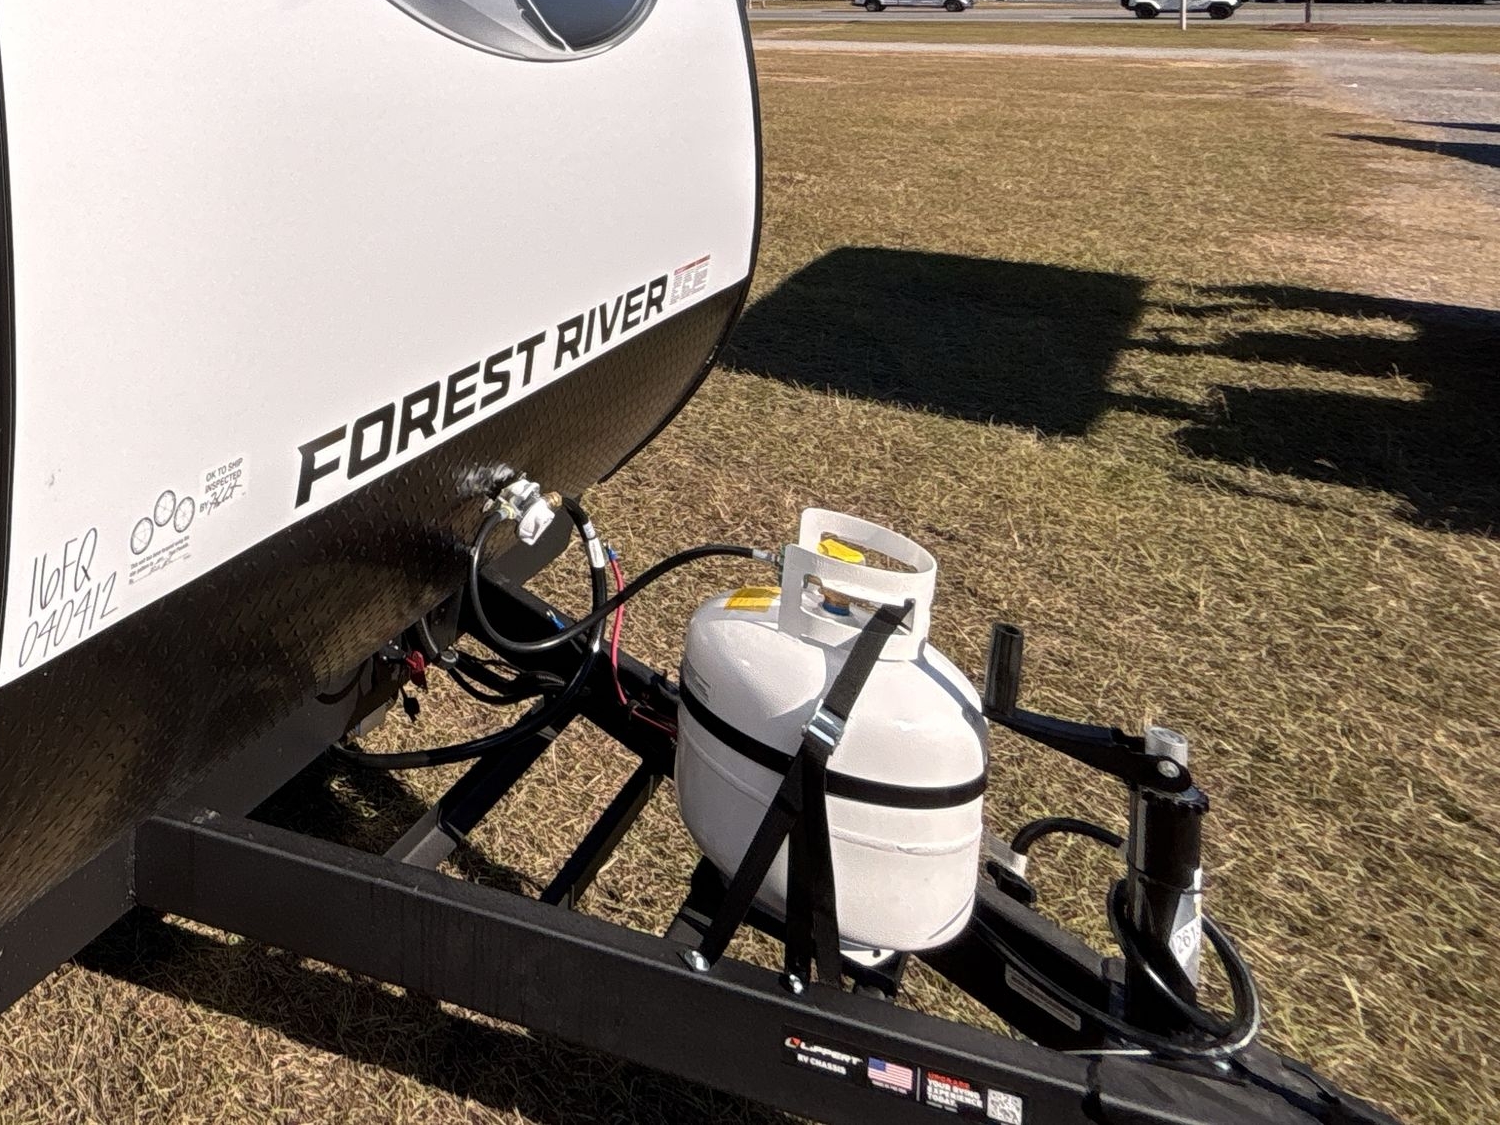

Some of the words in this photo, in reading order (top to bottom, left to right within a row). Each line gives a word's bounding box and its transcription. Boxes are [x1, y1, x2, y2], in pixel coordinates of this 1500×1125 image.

[295, 330, 547, 509] FOREST
[553, 274, 669, 371] RIVER
[28, 527, 98, 618] 16FQ
